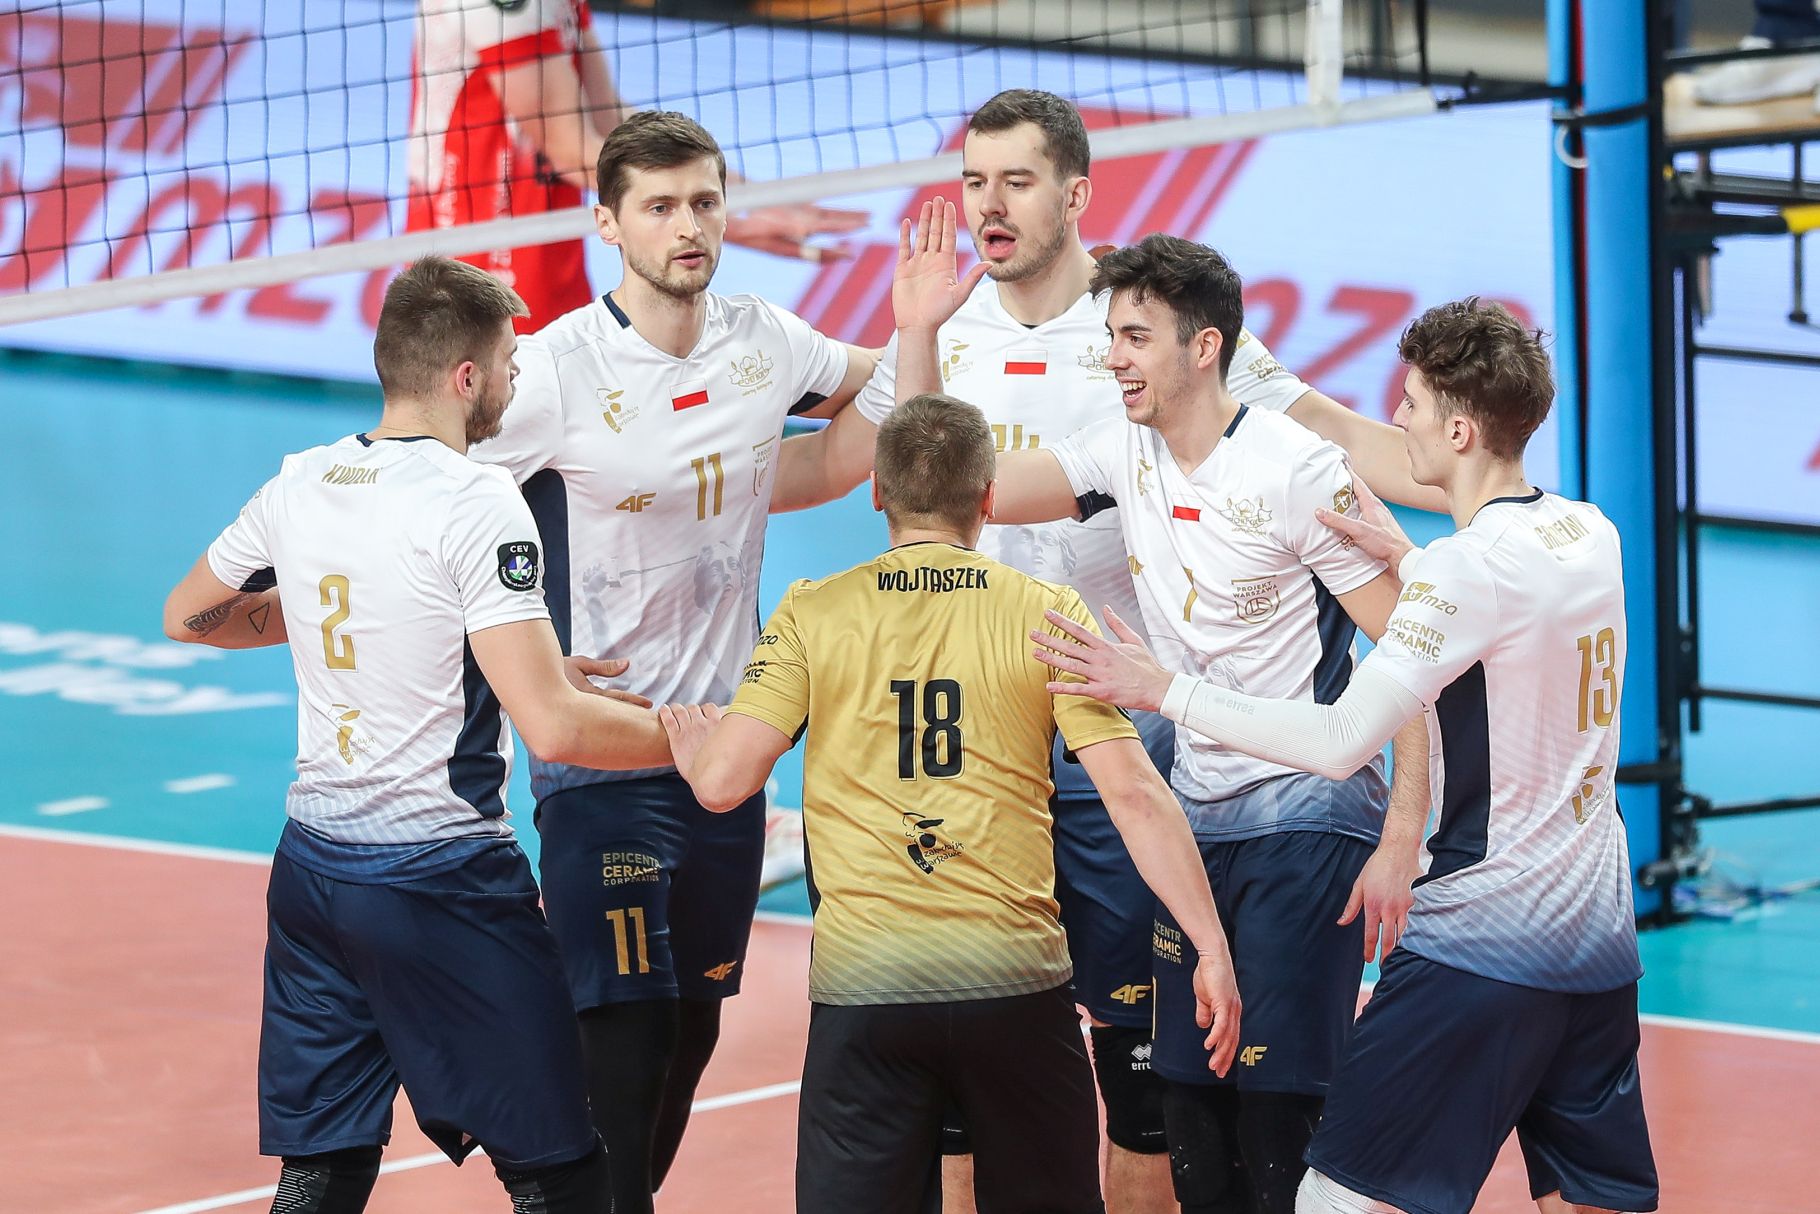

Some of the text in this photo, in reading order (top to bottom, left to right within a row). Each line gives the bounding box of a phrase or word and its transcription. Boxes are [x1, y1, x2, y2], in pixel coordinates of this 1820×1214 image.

[691, 452, 724, 521] 11
[616, 492, 656, 513] 4F
[510, 545, 529, 553] CEV
[878, 567, 988, 593] WOJTASZEK
[1233, 584, 1277, 598] WARSZAWA
[1236, 581, 1272, 592] PROJEKT
[319, 574, 358, 672] 2
[1388, 618, 1445, 645] PICENTR
[1389, 628, 1441, 657] ERAMIC
[1577, 627, 1617, 734] 13
[890, 679, 965, 782] 18
[602, 852, 662, 869] EPICENTR
[606, 907, 650, 975] 11
[704, 960, 738, 981] 4F
[1110, 984, 1151, 1005] 4F
[1240, 1045, 1268, 1066] 4F
